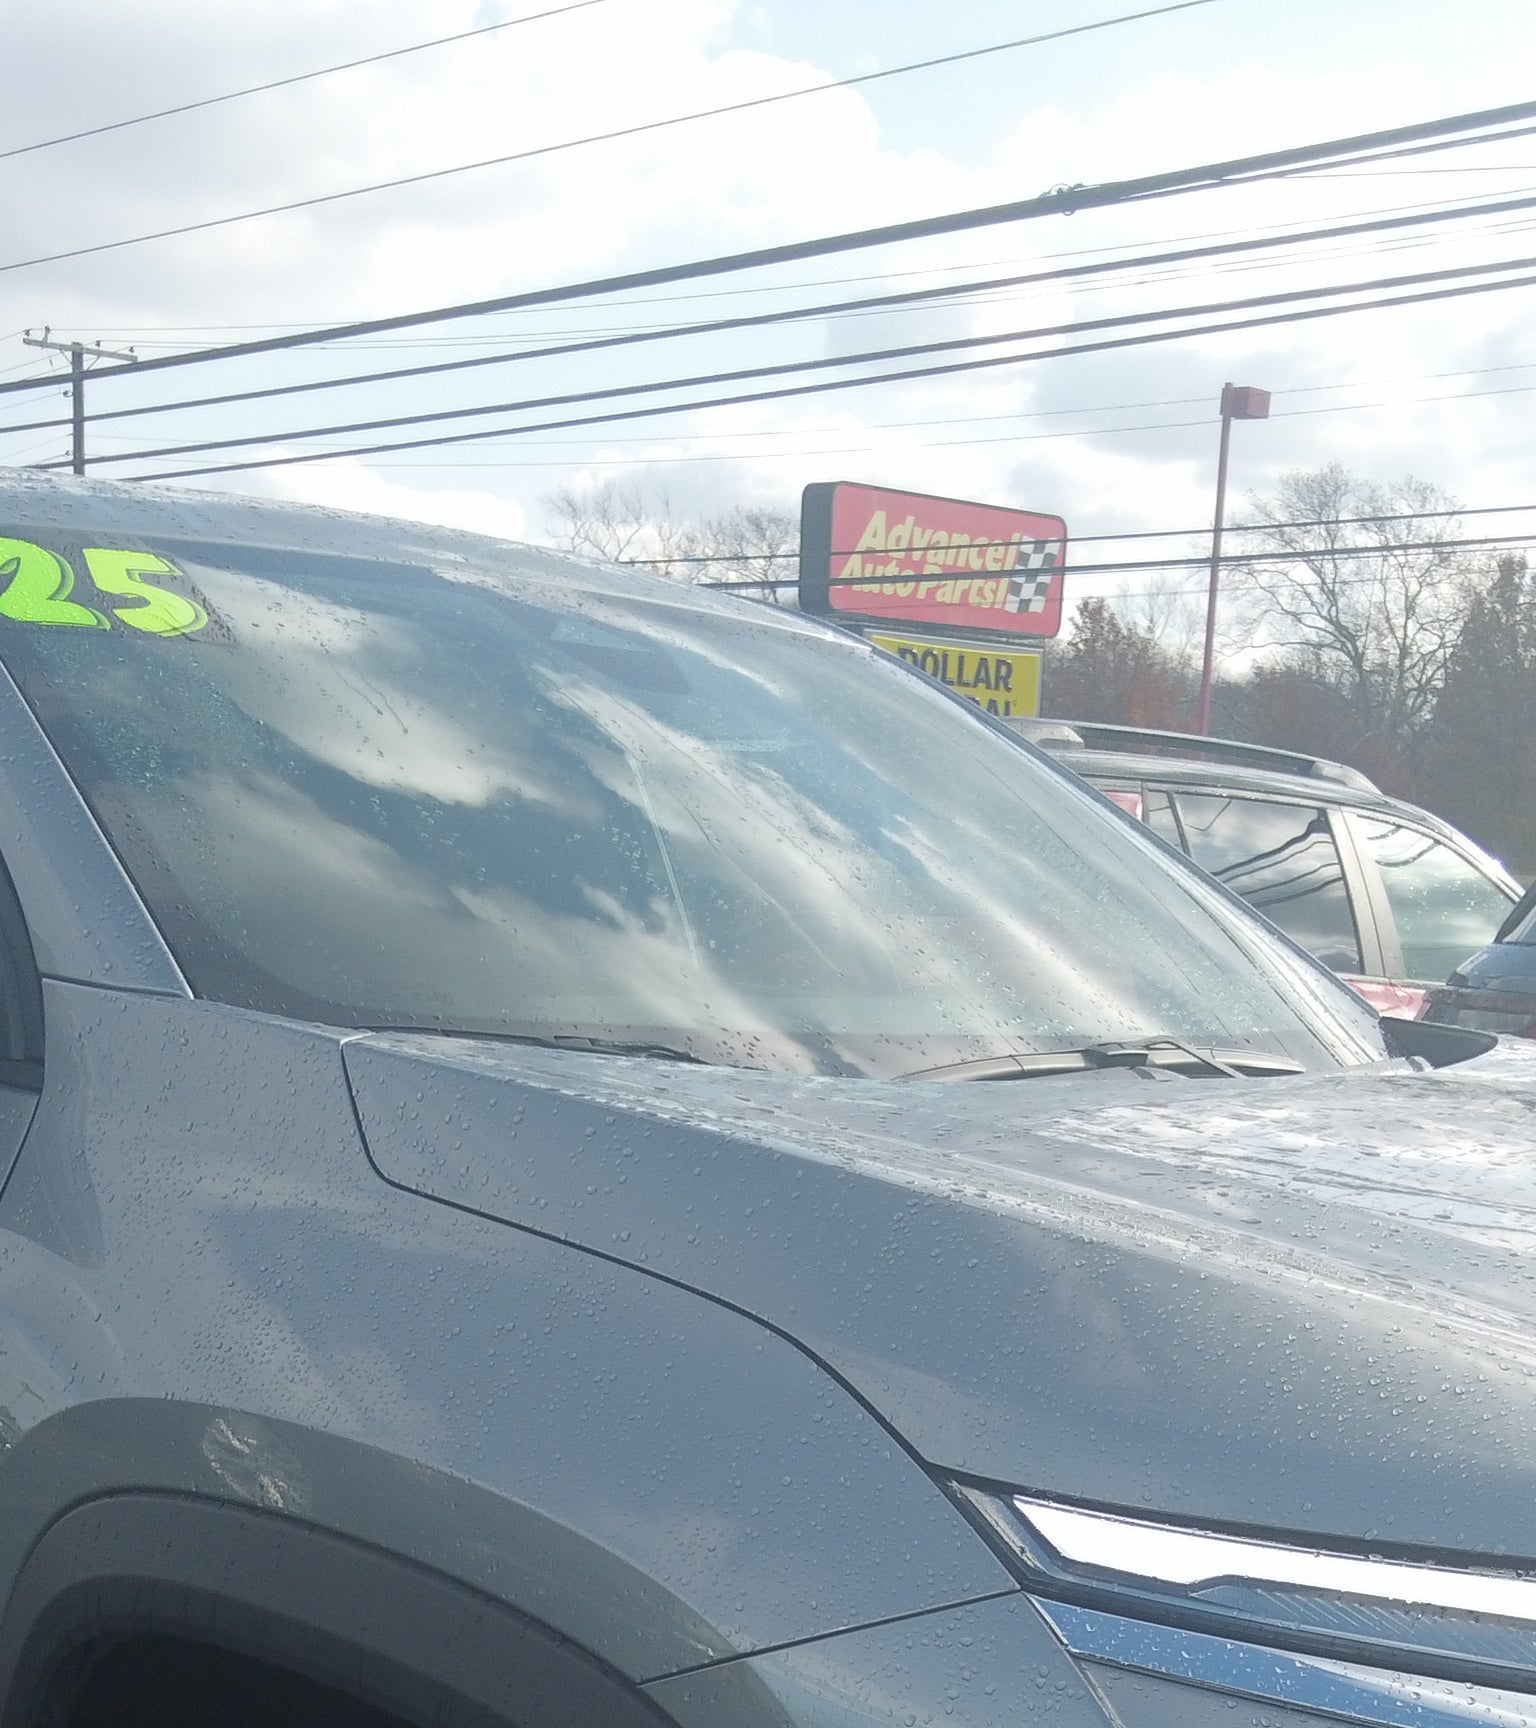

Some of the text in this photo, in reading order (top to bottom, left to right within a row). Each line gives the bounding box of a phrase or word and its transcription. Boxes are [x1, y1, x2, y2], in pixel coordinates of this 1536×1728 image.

[853, 510, 1005, 572] Advance
[837, 554, 1000, 608] Auto Parts
